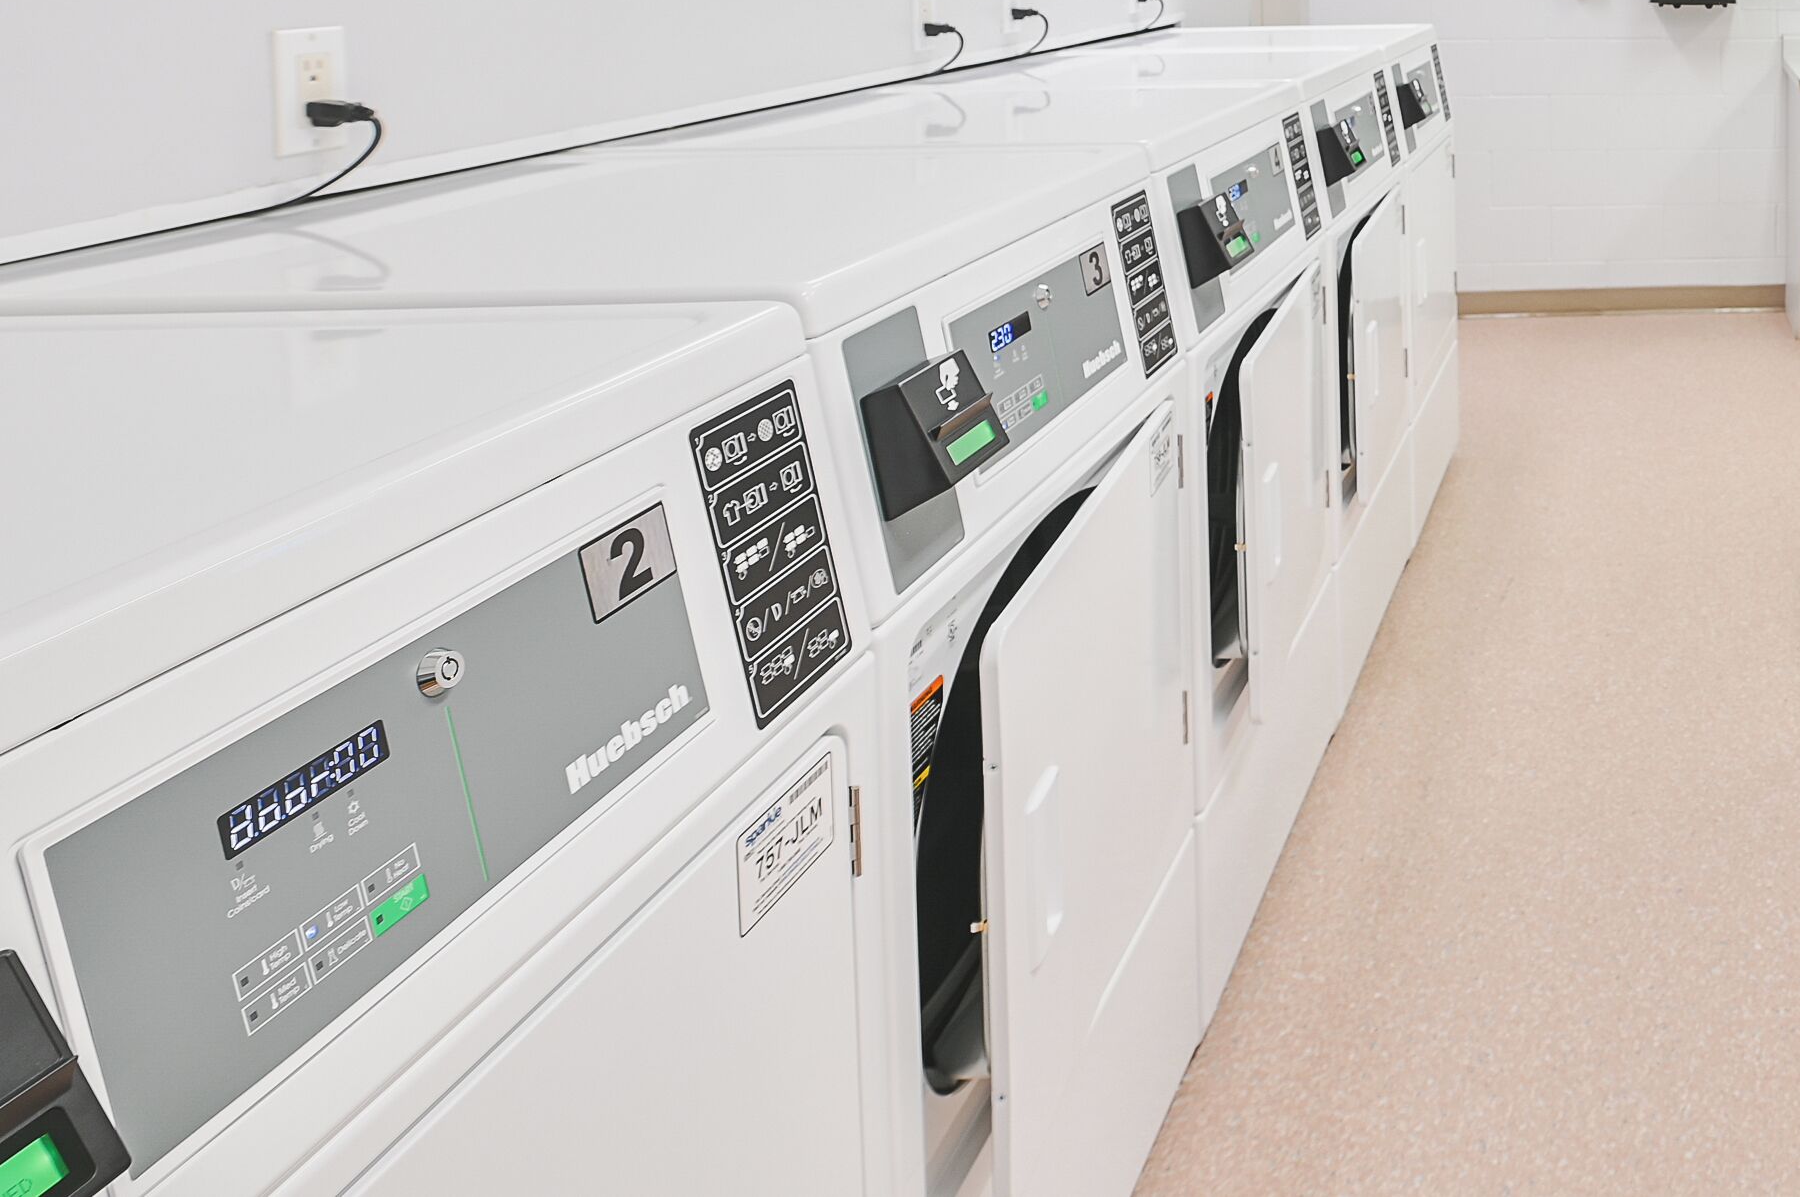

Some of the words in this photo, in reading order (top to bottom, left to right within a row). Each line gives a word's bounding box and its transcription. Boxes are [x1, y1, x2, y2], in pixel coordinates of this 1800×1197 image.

[1088, 251, 1103, 286] 3
[991, 323, 1013, 352] 230
[610, 527, 654, 602] 2
[565, 684, 690, 795] Huebsch
[348, 812, 365, 826] Cool
[348, 820, 368, 836] Down
[310, 834, 334, 853] Drying
[756, 797, 822, 879] 757-JLM
[394, 859, 406, 870] No
[333, 906, 354, 922] Temp
[334, 899, 348, 912] Low
[337, 930, 366, 954] Delicate
[269, 946, 288, 962] High
[269, 952, 292, 970] Temp
[278, 977, 296, 995] Med
[279, 986, 300, 1004] Temp
